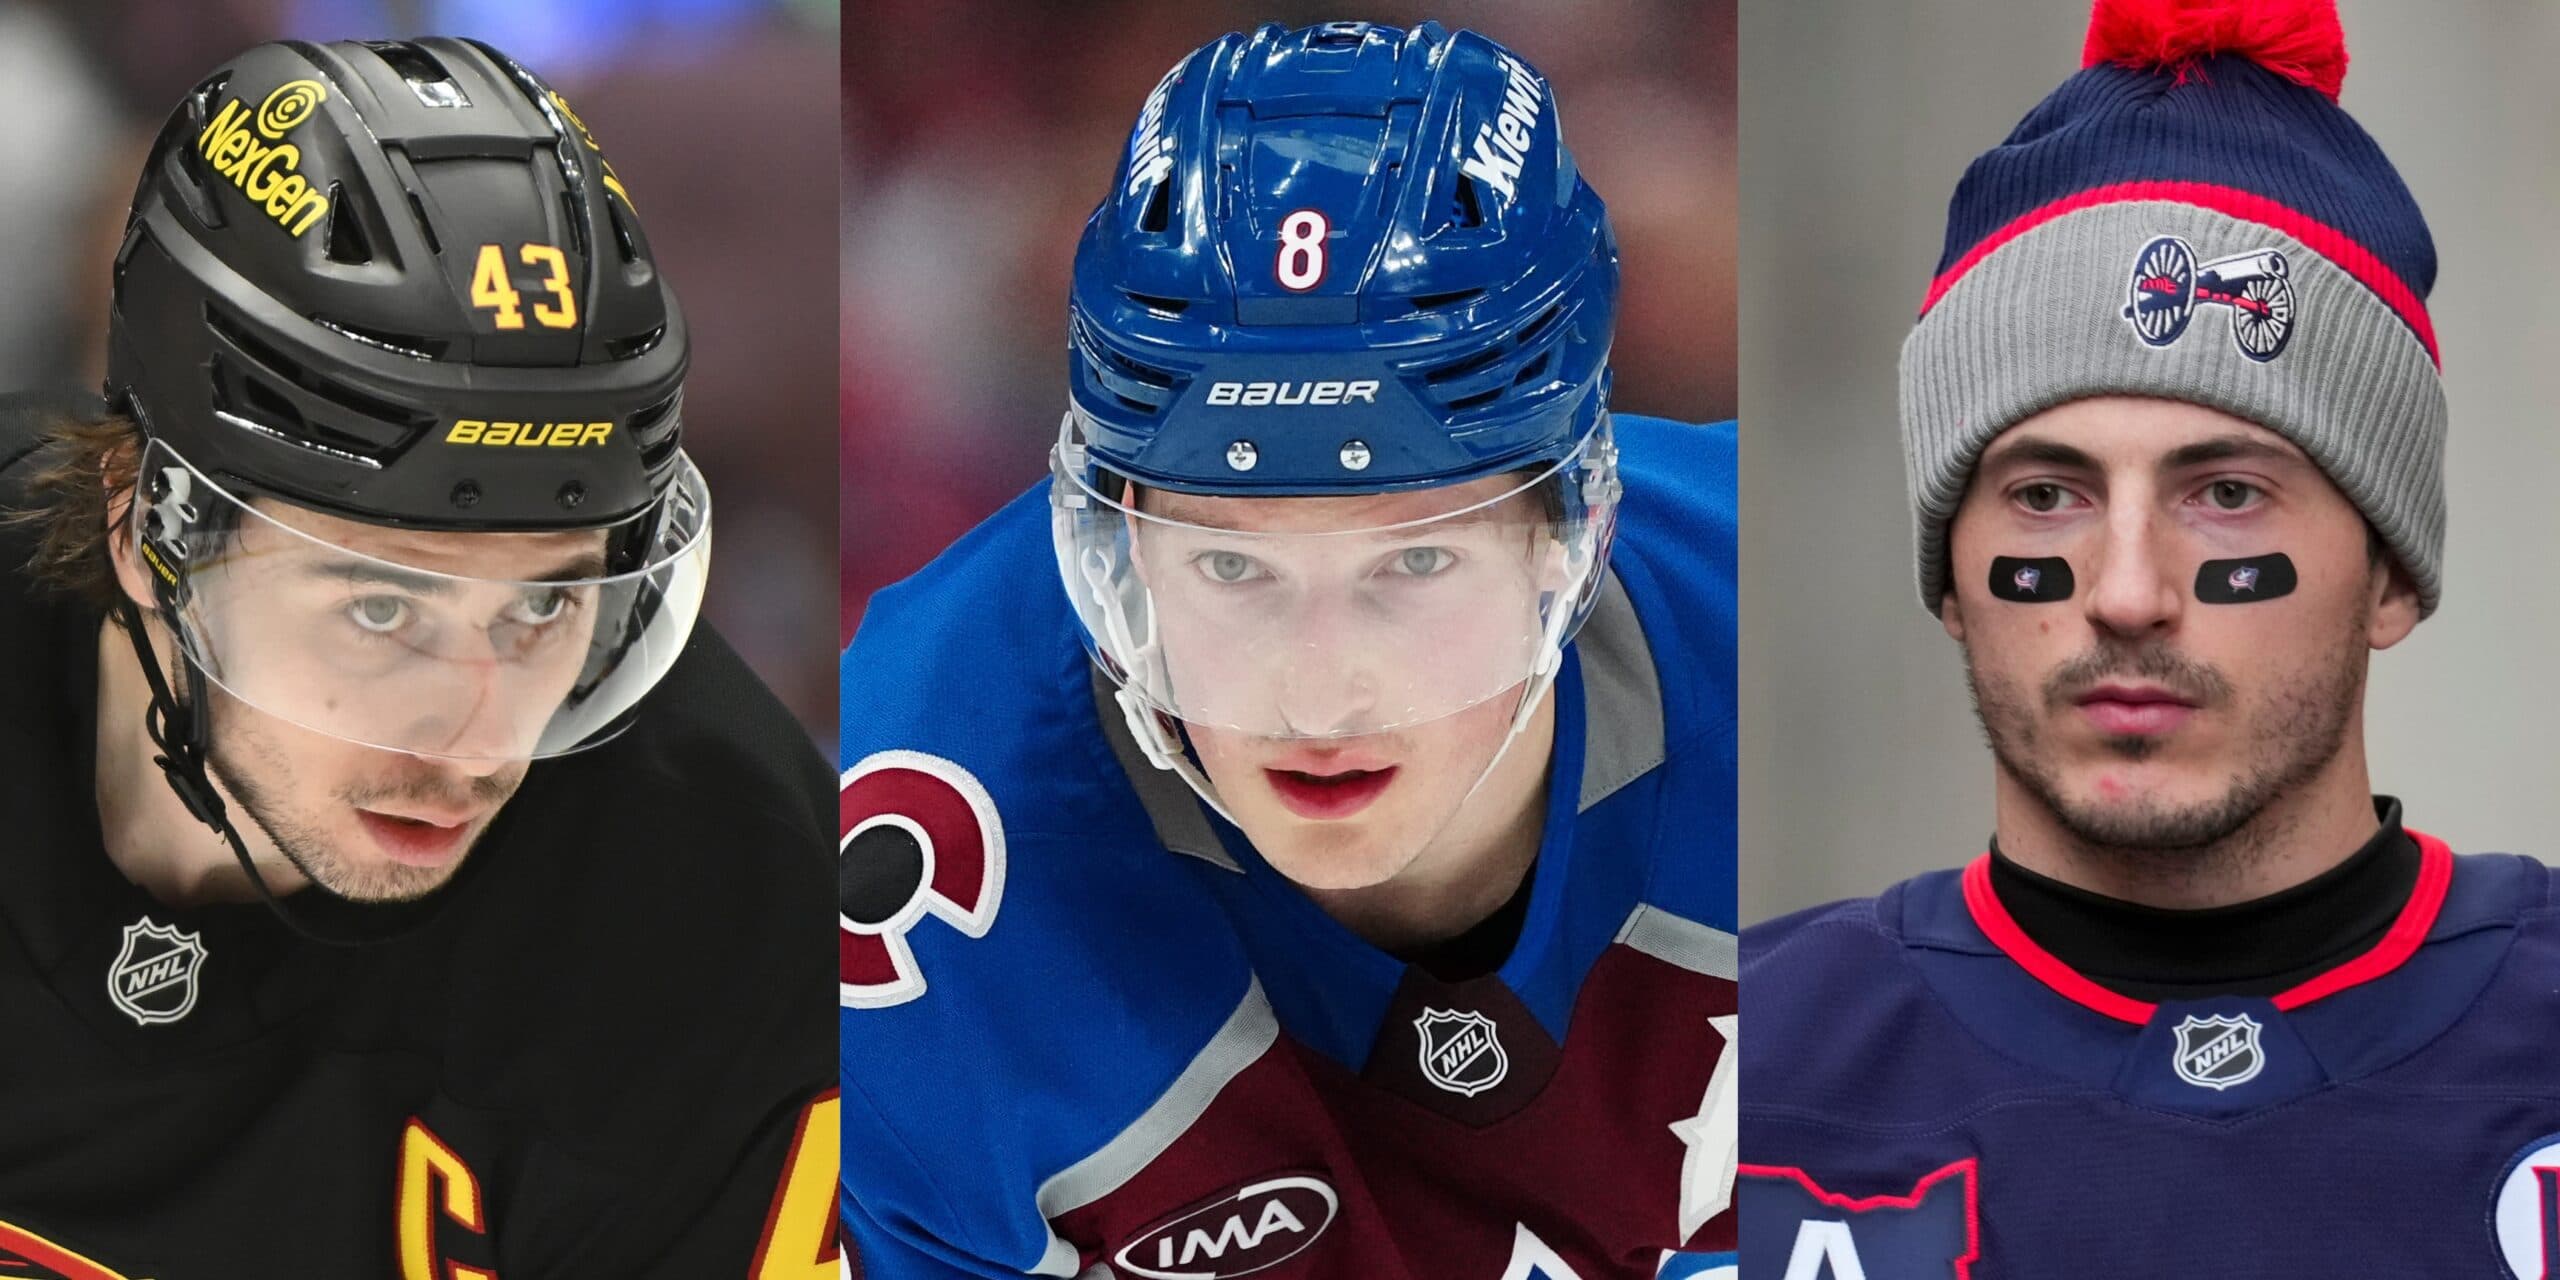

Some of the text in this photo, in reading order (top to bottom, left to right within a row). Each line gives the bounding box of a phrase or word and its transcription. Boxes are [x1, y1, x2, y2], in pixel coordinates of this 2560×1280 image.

[198, 98, 329, 237] NexGen
[1274, 207, 1331, 293] 8
[470, 243, 578, 330] 43
[1206, 380, 1380, 406] BAUER
[445, 419, 613, 446] BAUER
[127, 955, 186, 994] NHL
[1441, 1029, 1485, 1075] NHL
[2194, 1033, 2245, 1074] NHL
[393, 1114, 498, 1280] C
[1158, 1198, 1306, 1268] IMA
